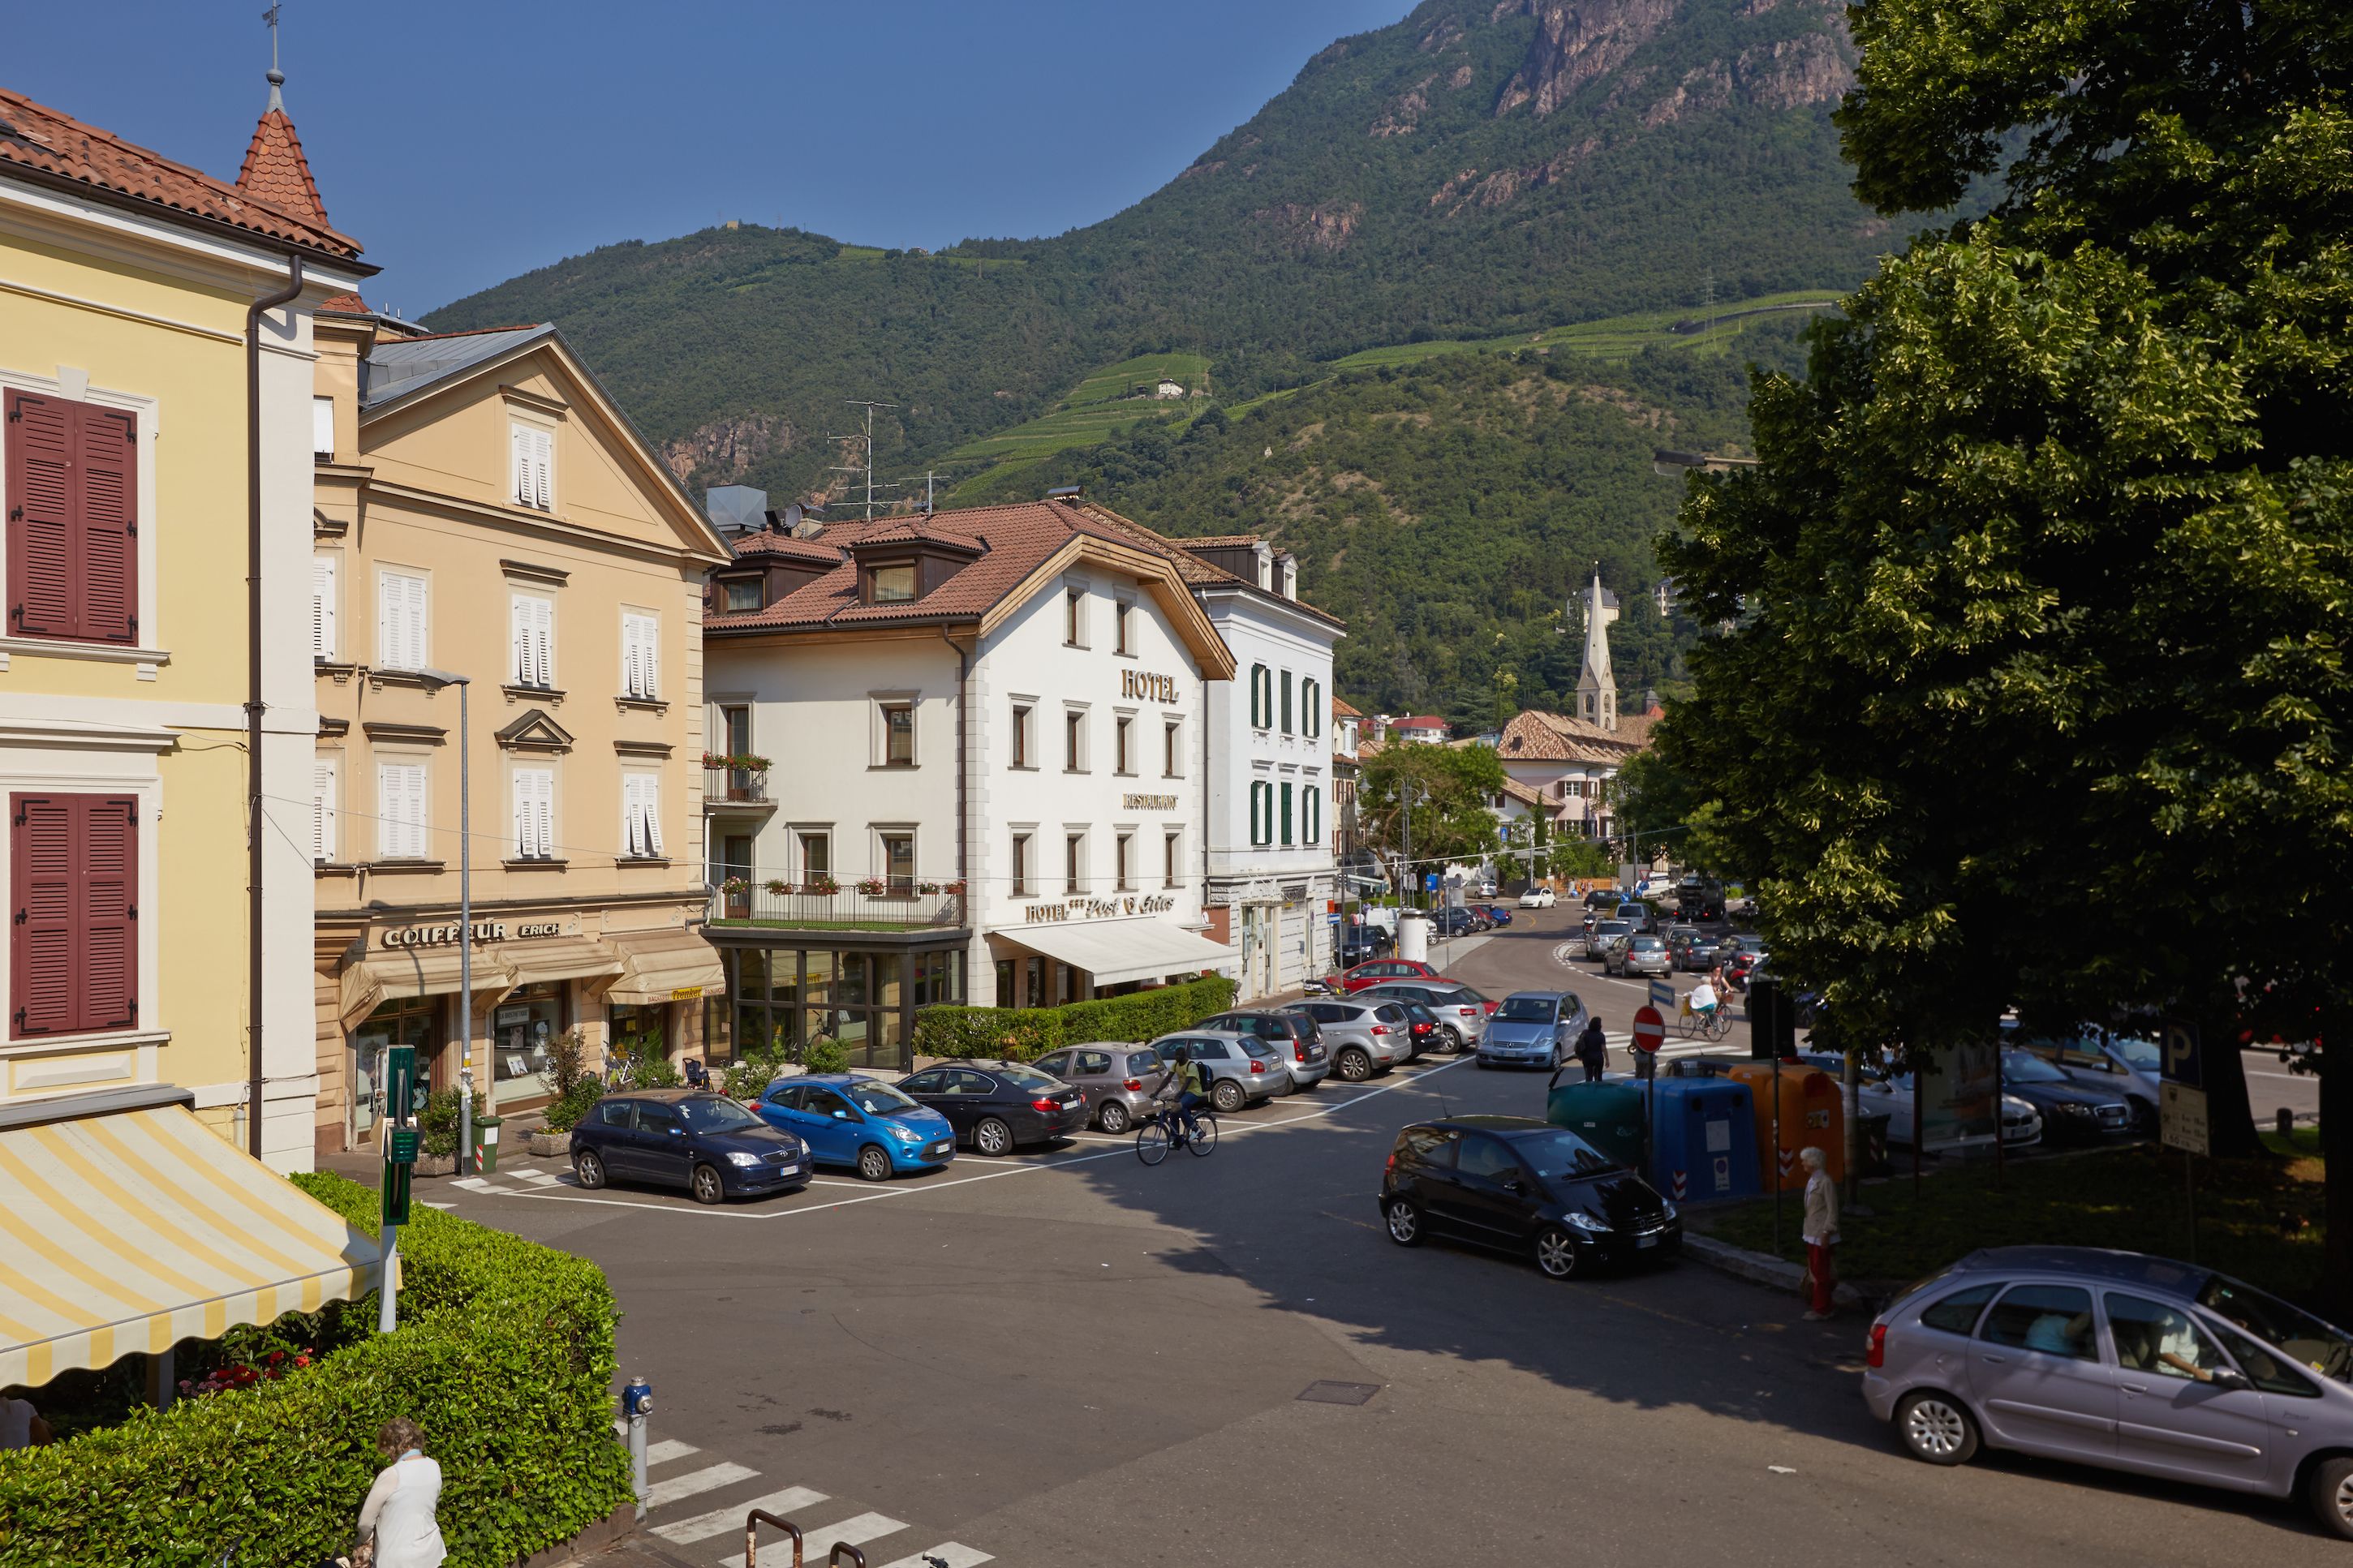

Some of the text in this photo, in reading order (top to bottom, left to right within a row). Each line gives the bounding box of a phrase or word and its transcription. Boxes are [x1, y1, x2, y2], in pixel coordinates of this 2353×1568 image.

[1122, 669, 1180, 704] HOTEL
[1123, 794, 1178, 810] RESTAURANT
[1026, 904, 1069, 923] HOTEL
[1086, 896, 1121, 917] Post
[519, 923, 560, 938] ERICH
[672, 988, 701, 1000] Trenker
[2168, 1026, 2192, 1074] P
